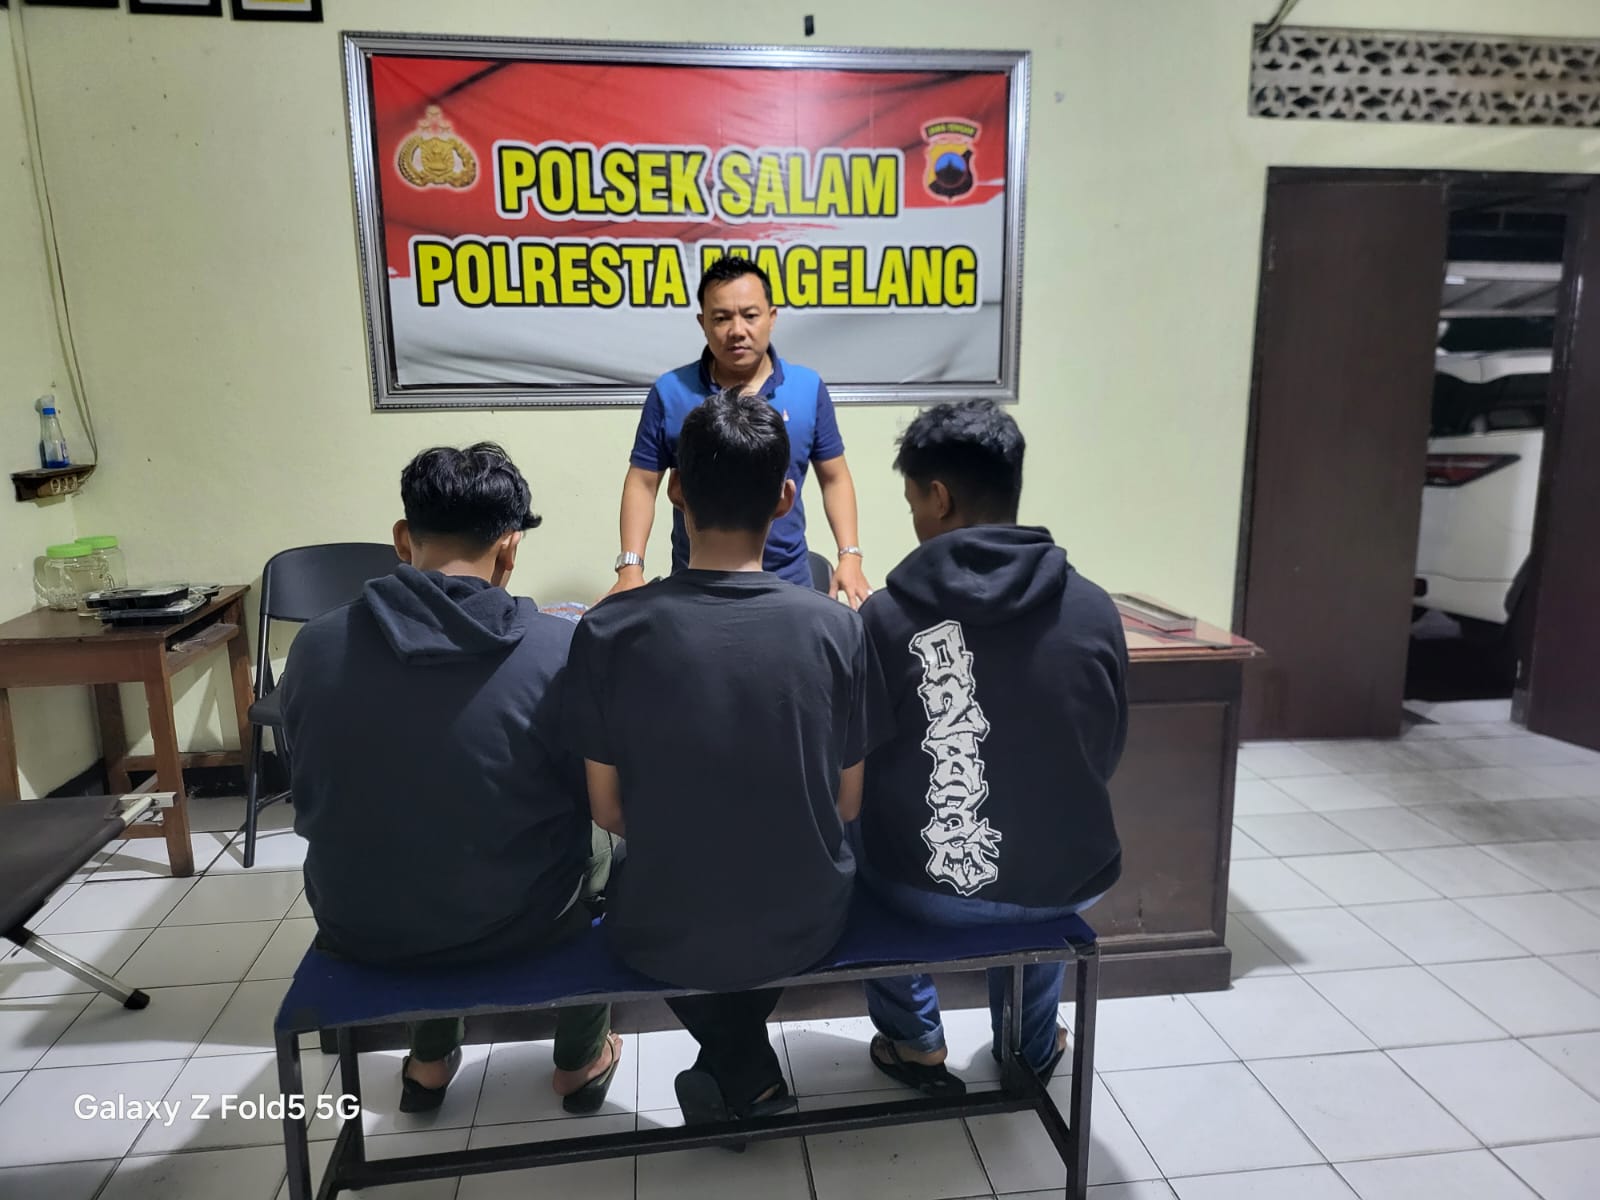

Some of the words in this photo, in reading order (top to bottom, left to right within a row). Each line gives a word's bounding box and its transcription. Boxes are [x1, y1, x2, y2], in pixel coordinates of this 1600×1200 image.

[498, 146, 709, 215] POLSEK
[717, 149, 899, 218] SALAM
[414, 240, 691, 309] POLRESTA
